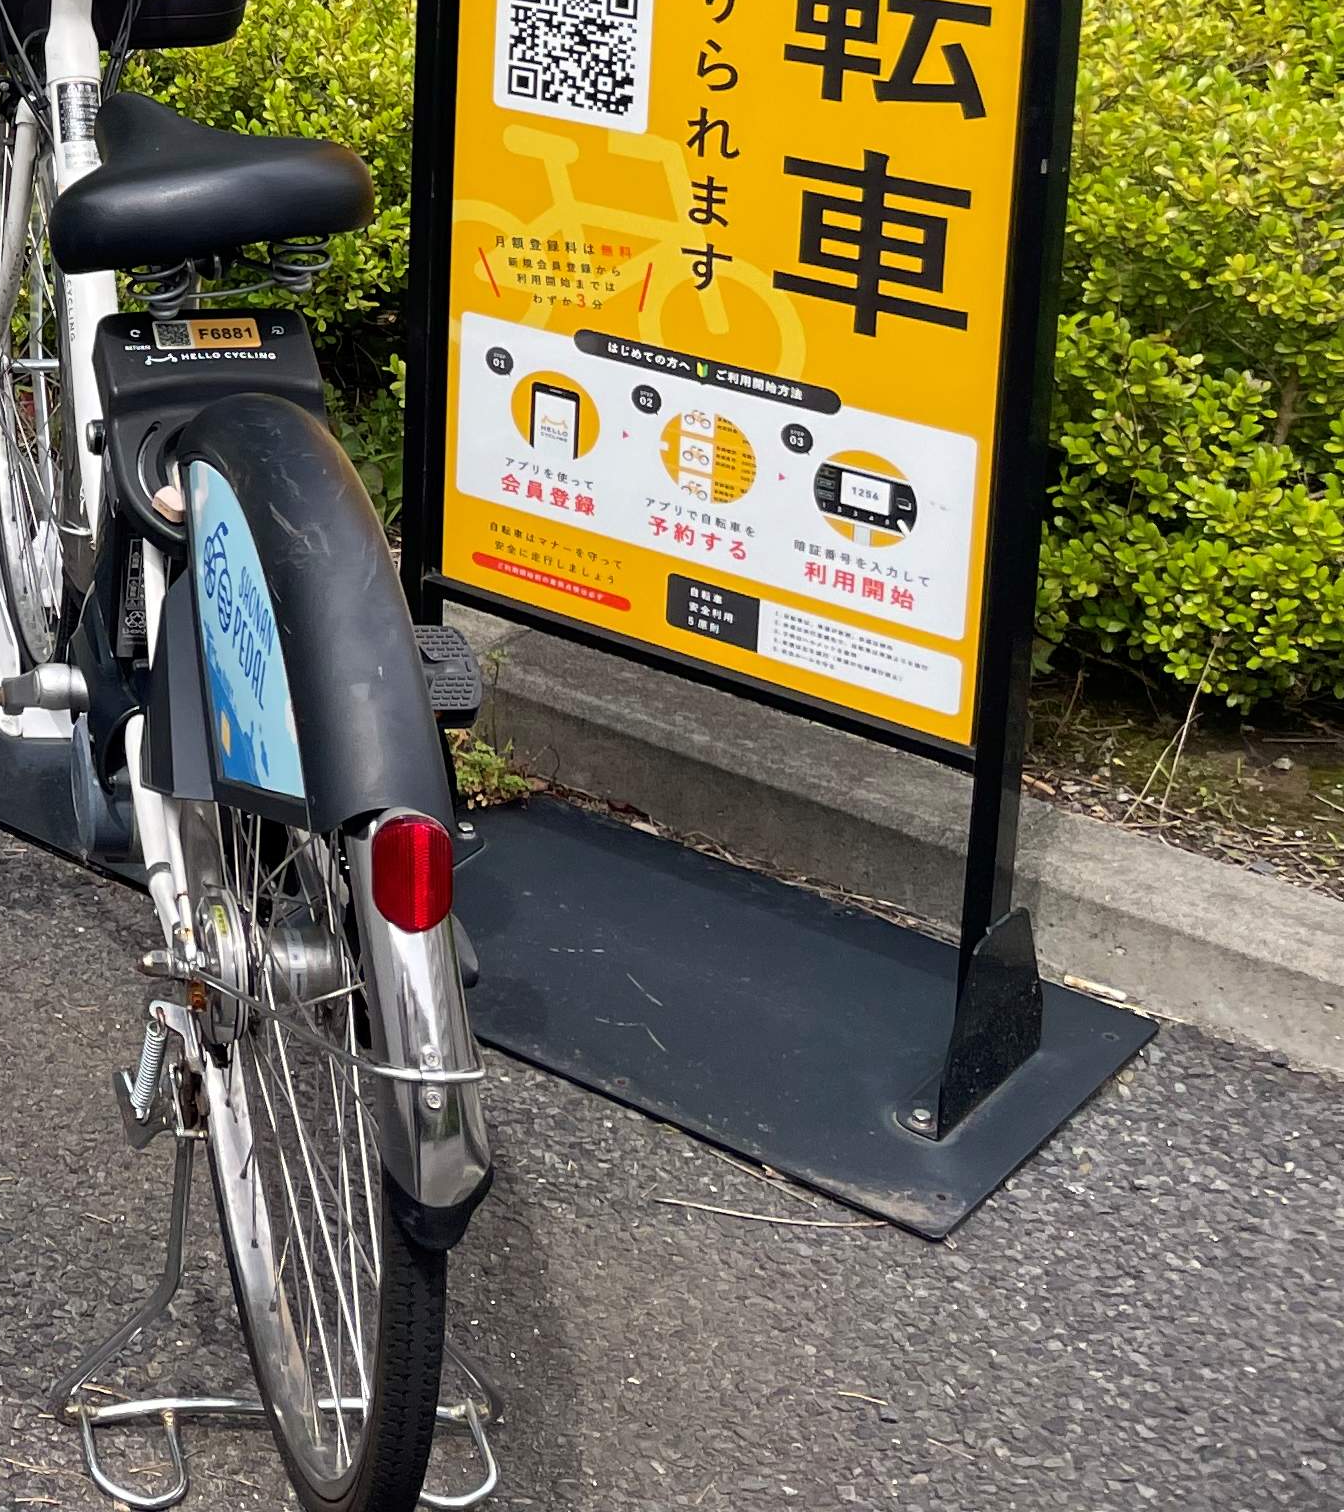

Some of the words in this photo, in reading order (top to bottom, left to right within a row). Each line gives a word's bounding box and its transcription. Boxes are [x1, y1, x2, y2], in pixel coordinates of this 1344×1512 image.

[495, 235, 632, 259] 月額登録料は無料
[508, 257, 620, 277] 新規会員登録から
[516, 273, 615, 292] 利用開始までは
[532, 293, 603, 311] わずか3分
[198, 327, 253, 341] F6881
[180, 352, 221, 361] HELLO
[224, 351, 277, 361] CYCLING
[492, 358, 505, 369] 01
[608, 341, 690, 371] はじめての方へ
[716, 370, 803, 401] ご利用開始方法
[639, 396, 653, 407] 02
[789, 435, 803, 446] 03
[504, 457, 594, 489] アプリを使って
[500, 474, 595, 517] 会員登録
[644, 497, 755, 537] アプリで自転車を
[489, 521, 622, 570] 自転車はマナーを守って
[648, 515, 747, 560] 予約する
[494, 540, 614, 585] 安全に走行しましょう
[794, 539, 930, 587] 暗証番号を入力して
[689, 586, 723, 605] 自転車
[804, 561, 915, 610] 利用開始
[237, 565, 276, 656] SHONAN
[688, 600, 734, 624] 安全利用
[233, 609, 265, 710] PEDAL
